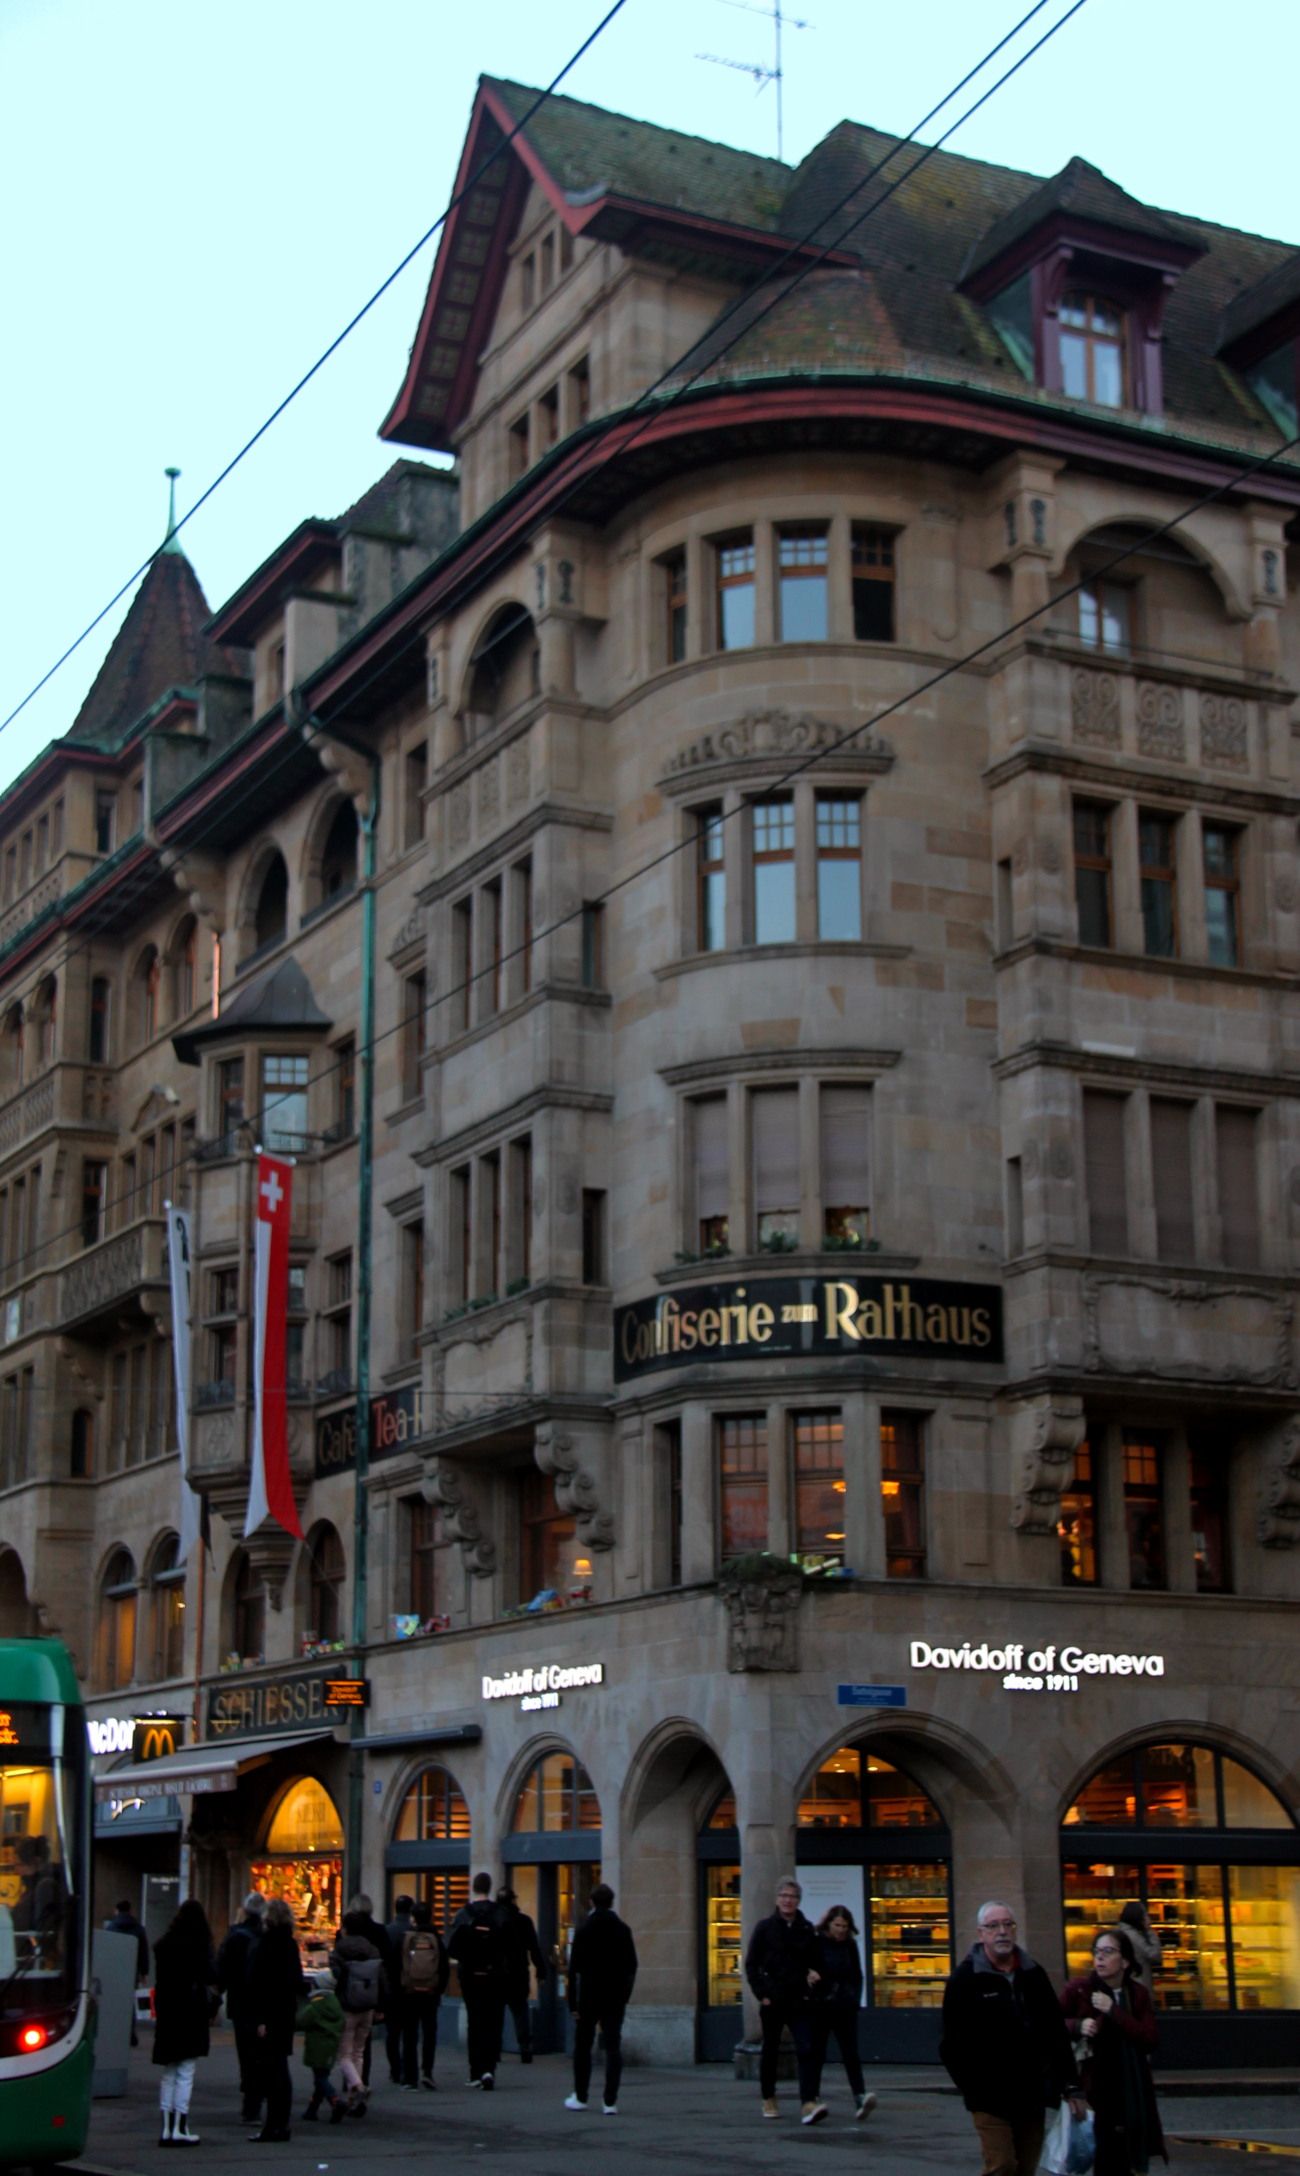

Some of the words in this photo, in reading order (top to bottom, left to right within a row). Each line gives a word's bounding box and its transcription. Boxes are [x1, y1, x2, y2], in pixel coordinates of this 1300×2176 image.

[620, 1287, 775, 1365] Confiserie
[781, 1303, 818, 1324] zum
[824, 1281, 993, 1347] Rathaus
[909, 1640, 1024, 1672] Davidoff
[1027, 1645, 1056, 1673] of
[1060, 1646, 1166, 1677] Geneva
[482, 1667, 534, 1699] Davidoff
[533, 1666, 548, 1692] of
[548, 1663, 603, 1690] Geneva
[1002, 1673, 1044, 1691] since
[1045, 1674, 1079, 1692] 1911
